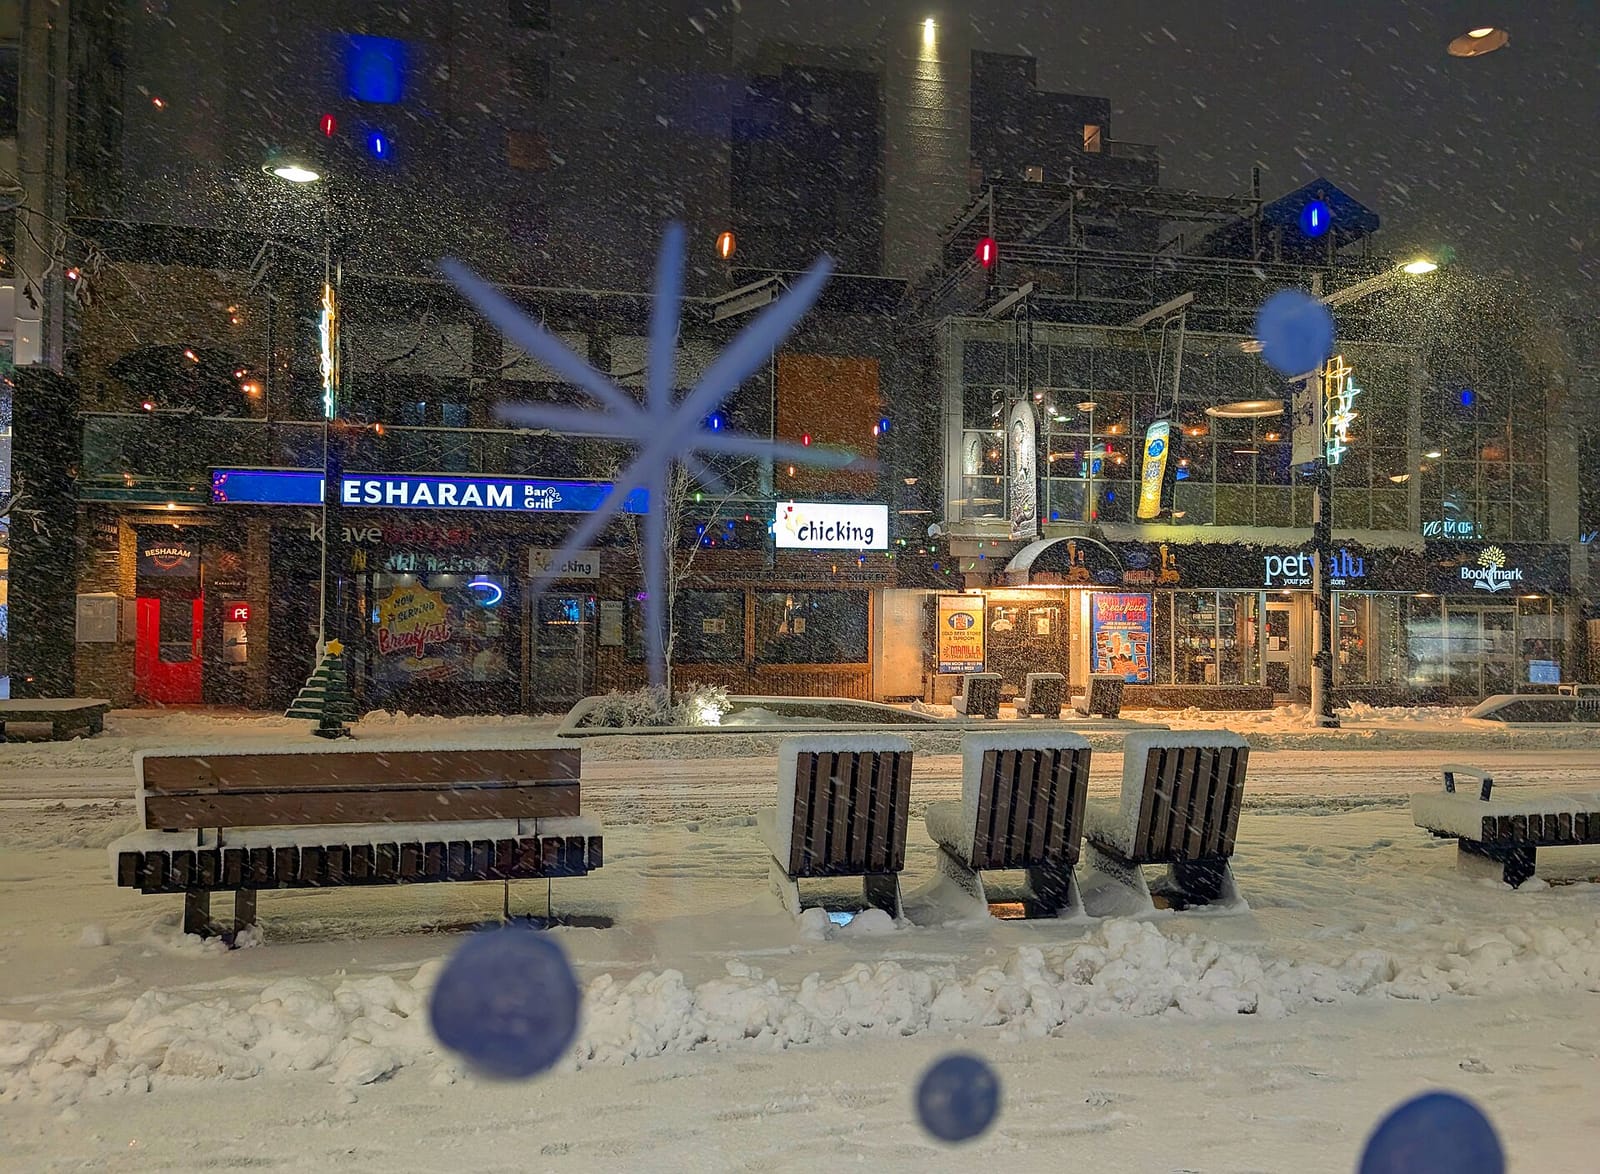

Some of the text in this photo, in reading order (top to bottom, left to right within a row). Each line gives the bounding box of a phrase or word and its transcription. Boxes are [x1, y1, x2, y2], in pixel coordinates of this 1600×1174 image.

[320, 480, 512, 507] ESHARAM
[524, 485, 547, 497] Bar
[524, 497, 553, 509] Grill
[310, 522, 382, 543] kave
[797, 521, 874, 545] chicking
[145, 548, 192, 559] BESHARAM
[395, 593, 414, 609] NOW
[378, 622, 451, 659] Breakfast
